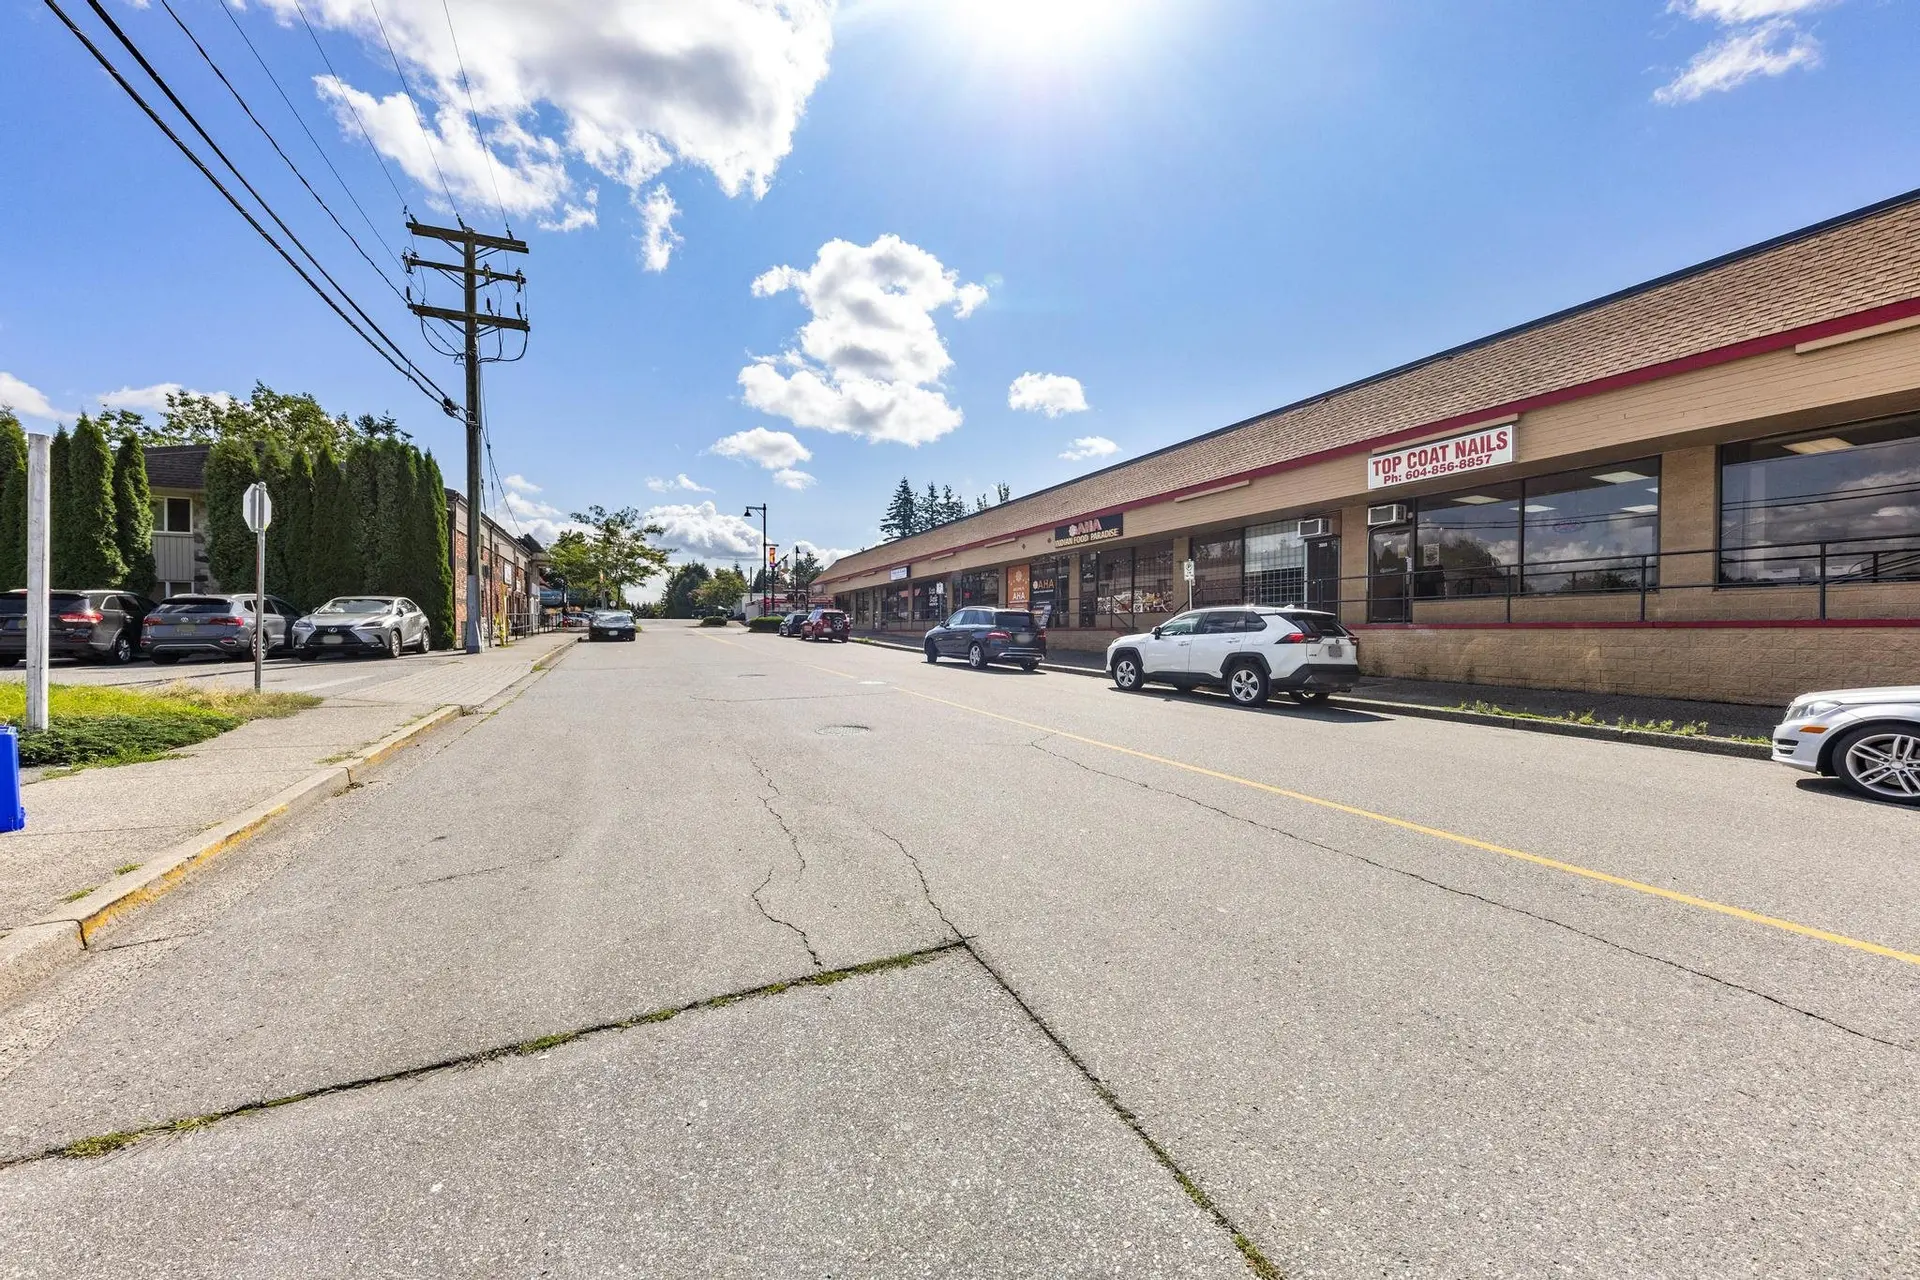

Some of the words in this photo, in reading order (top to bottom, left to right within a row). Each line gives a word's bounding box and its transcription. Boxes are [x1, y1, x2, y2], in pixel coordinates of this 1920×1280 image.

[1373, 456, 1402, 476] TOP
[1407, 445, 1449, 469] COAT
[1455, 431, 1508, 459] NAILS
[1383, 474, 1402, 485] Ph:
[1406, 454, 1493, 480] 604-856-8857
[1074, 534, 1088, 544] FOOD
[1090, 528, 1118, 540] PARADISE
[1038, 580, 1054, 589] AHA
[1012, 592, 1025, 600] AHA
